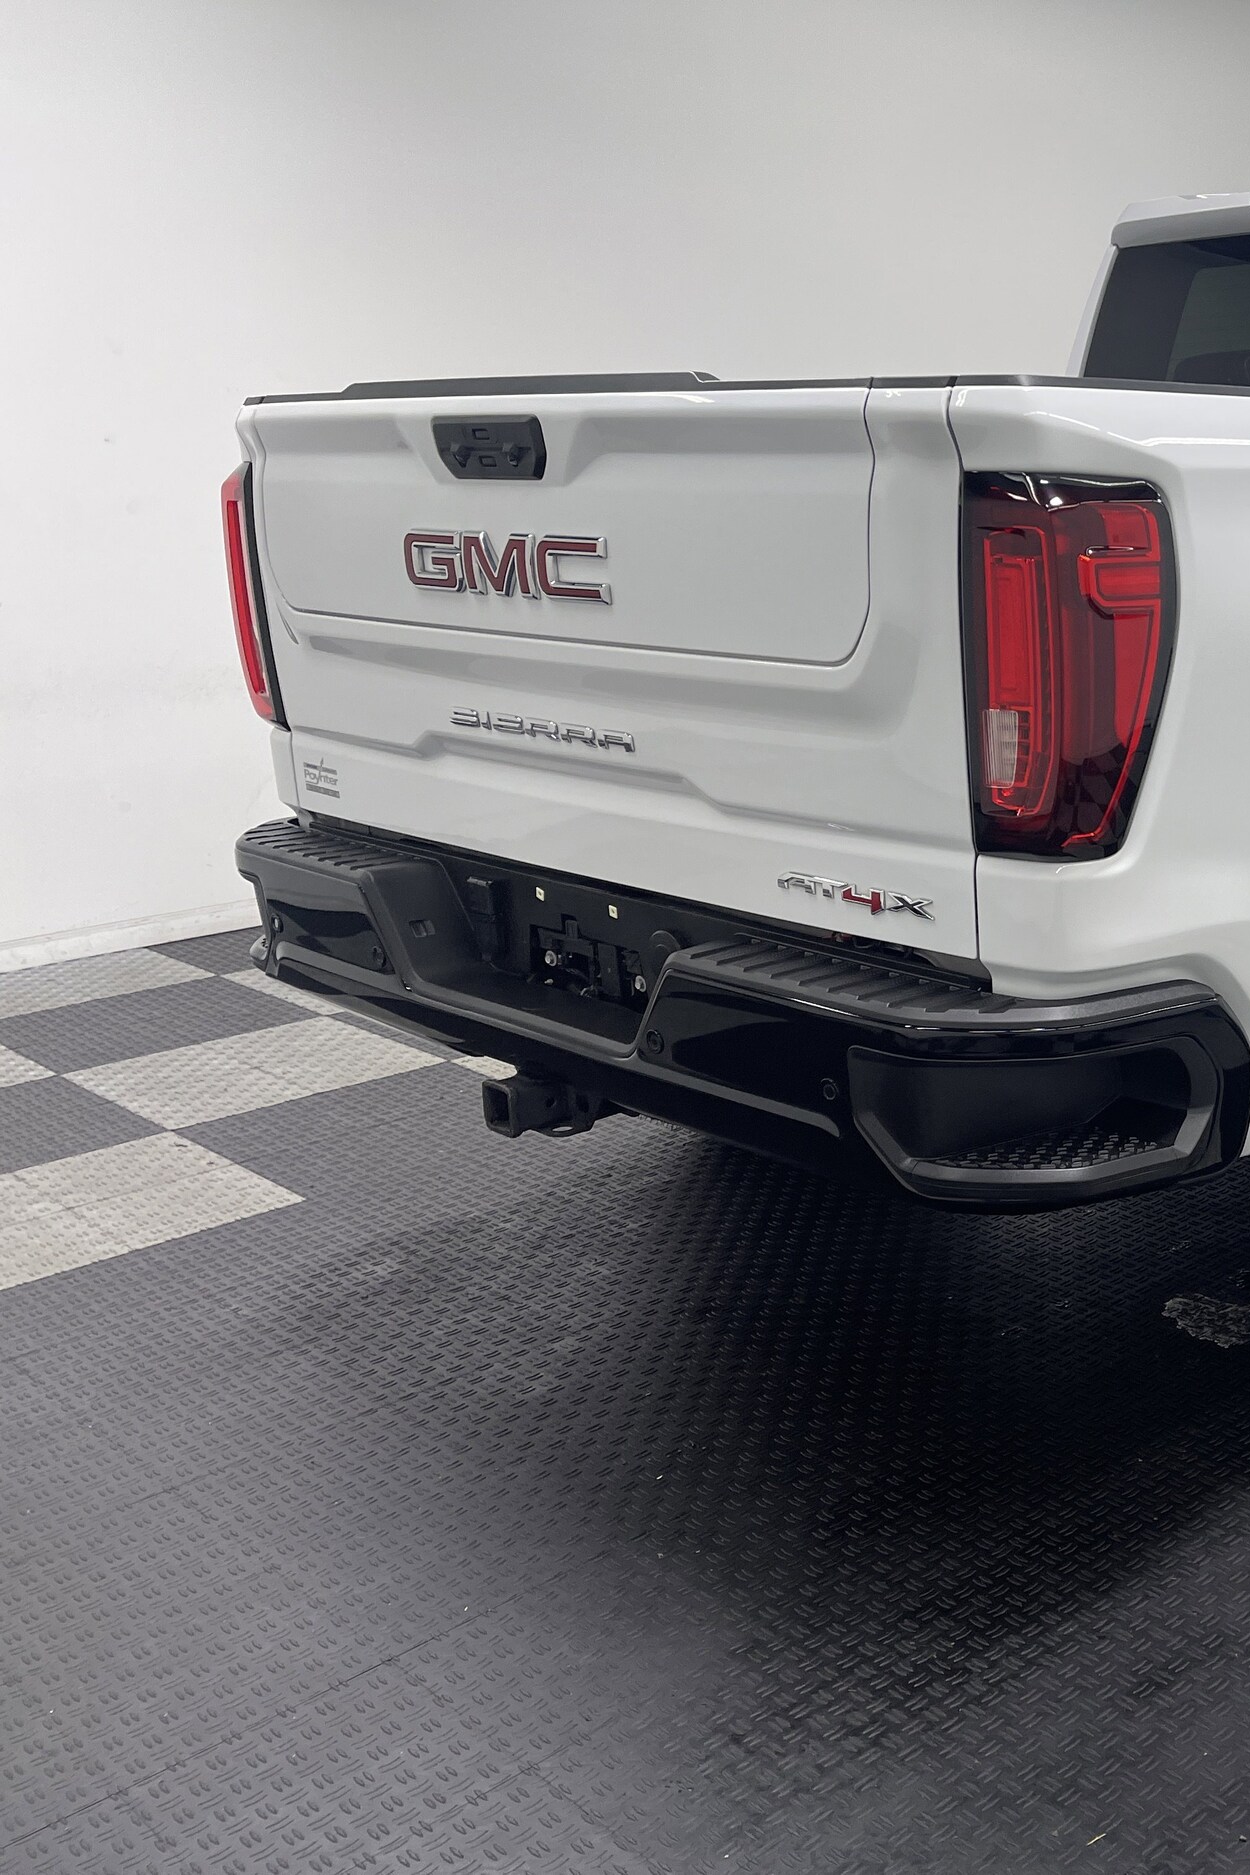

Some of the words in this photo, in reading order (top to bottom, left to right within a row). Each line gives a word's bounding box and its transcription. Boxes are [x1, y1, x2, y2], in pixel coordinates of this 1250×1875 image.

[403, 529, 613, 605] GMC
[450, 706, 636, 752] SIERRA
[303, 768, 338, 786] Poynter
[777, 871, 935, 921] AT4X
